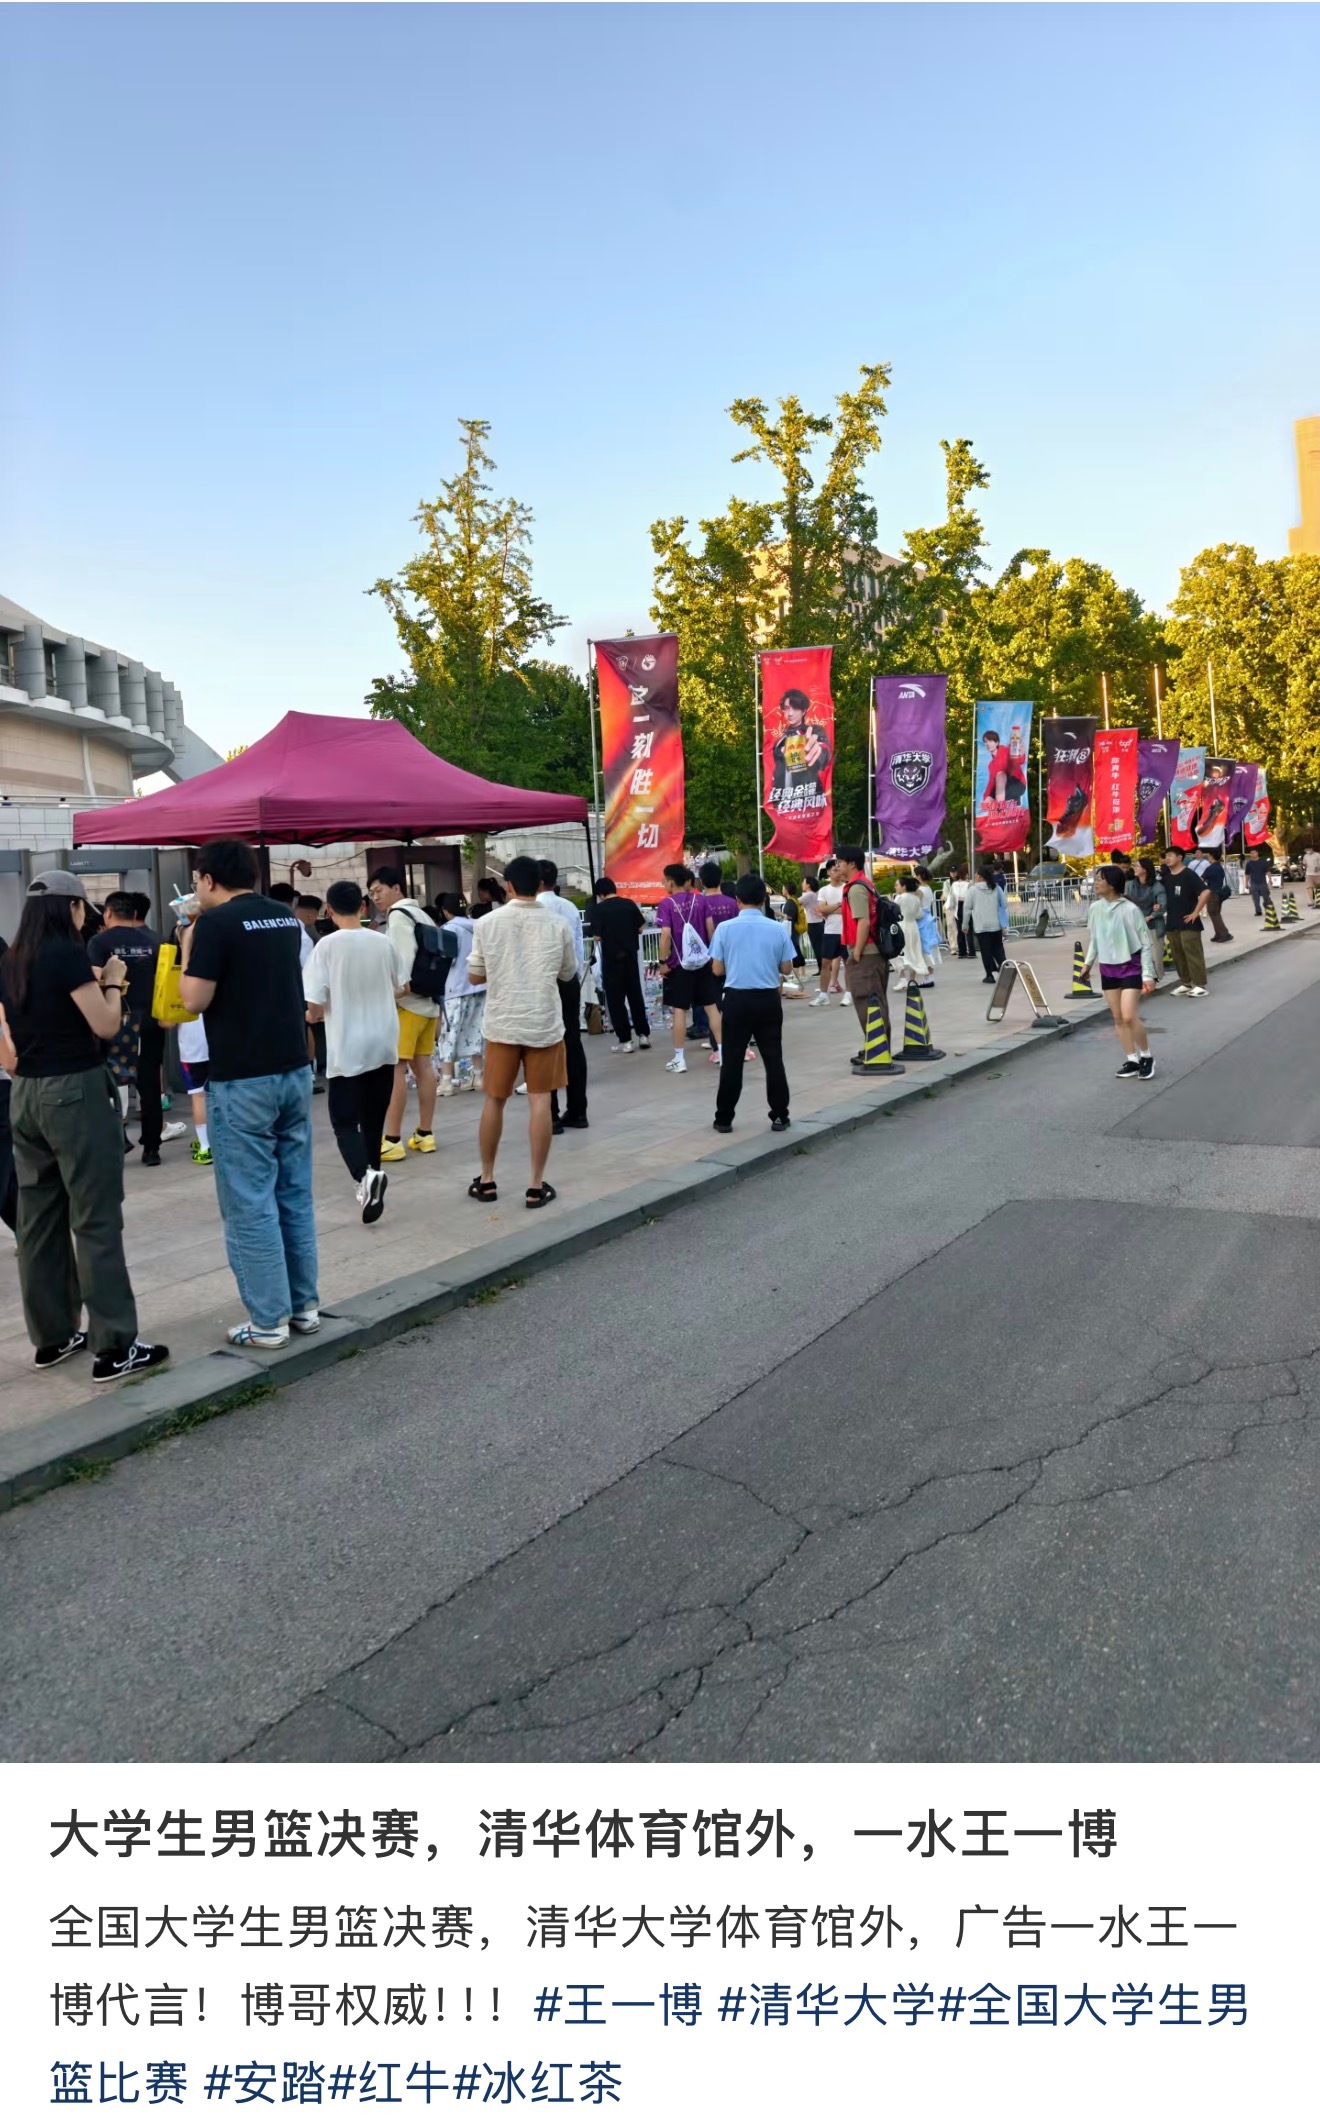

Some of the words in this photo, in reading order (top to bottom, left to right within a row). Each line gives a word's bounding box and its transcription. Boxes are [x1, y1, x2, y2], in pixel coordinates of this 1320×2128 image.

[627, 684, 659, 848] 这一刻胜一切
[892, 753, 931, 765] 清华大学
